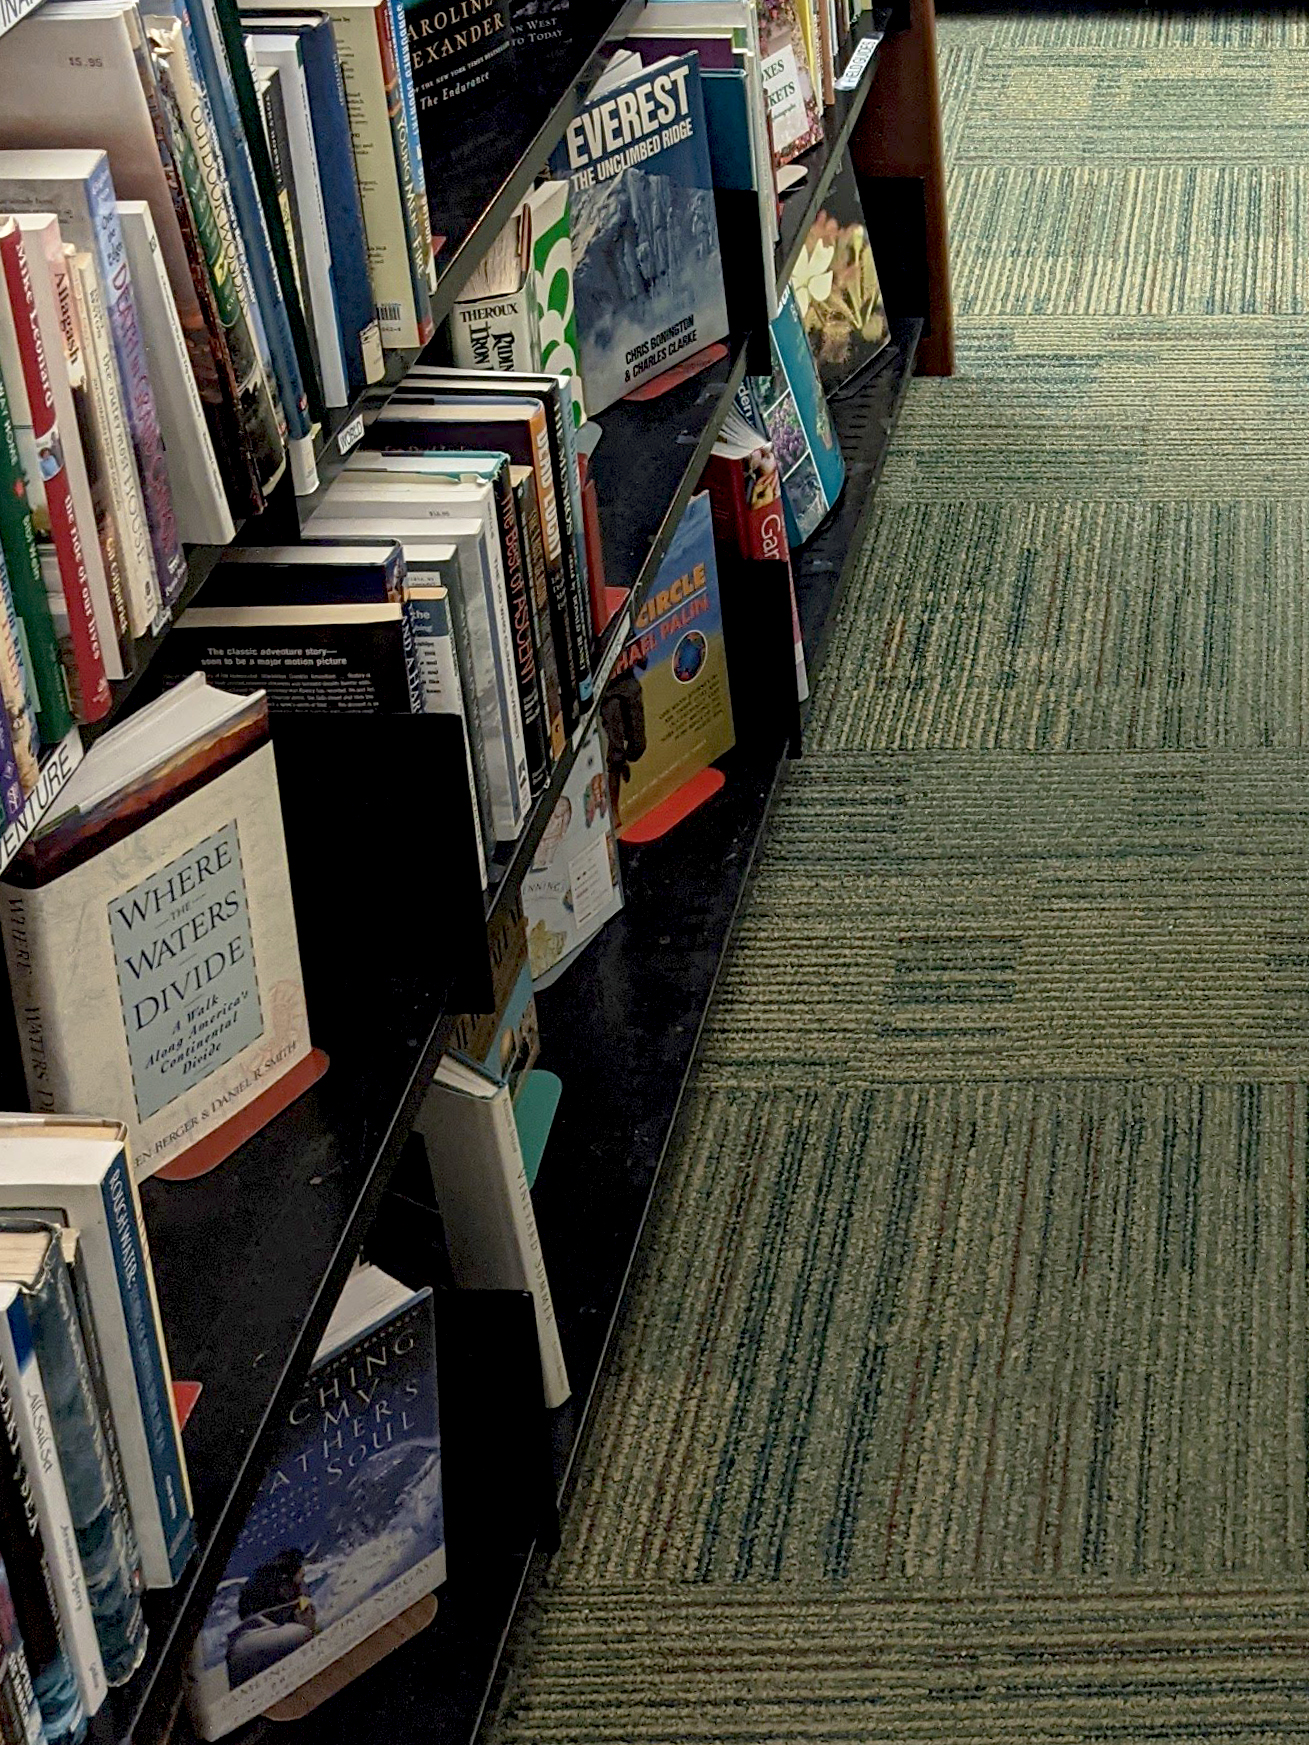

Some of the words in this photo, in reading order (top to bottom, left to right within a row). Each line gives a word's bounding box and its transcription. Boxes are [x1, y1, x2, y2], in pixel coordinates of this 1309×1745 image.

[525, 14, 558, 33] WEST
[420, 94, 438, 112] The
[566, 64, 691, 169] EVEREST
[570, 164, 596, 194] THE
[598, 133, 662, 182] UNCLIMBED
[663, 117, 695, 154] RIDGE
[404, 183, 420, 223] MEN
[53, 271, 81, 366] Allagash
[459, 303, 519, 324] THEROUX
[624, 345, 649, 366] CHRIS
[650, 314, 695, 356] BONINGTON
[28, 311, 54, 409] Leonard
[339, 419, 363, 448] WORLD
[635, 562, 706, 630] CIRCLE
[261, 647, 304, 657] adventure
[115, 838, 235, 934] WHERE
[122, 890, 241, 984] WATERS
[131, 934, 247, 1033] DIVIDE
